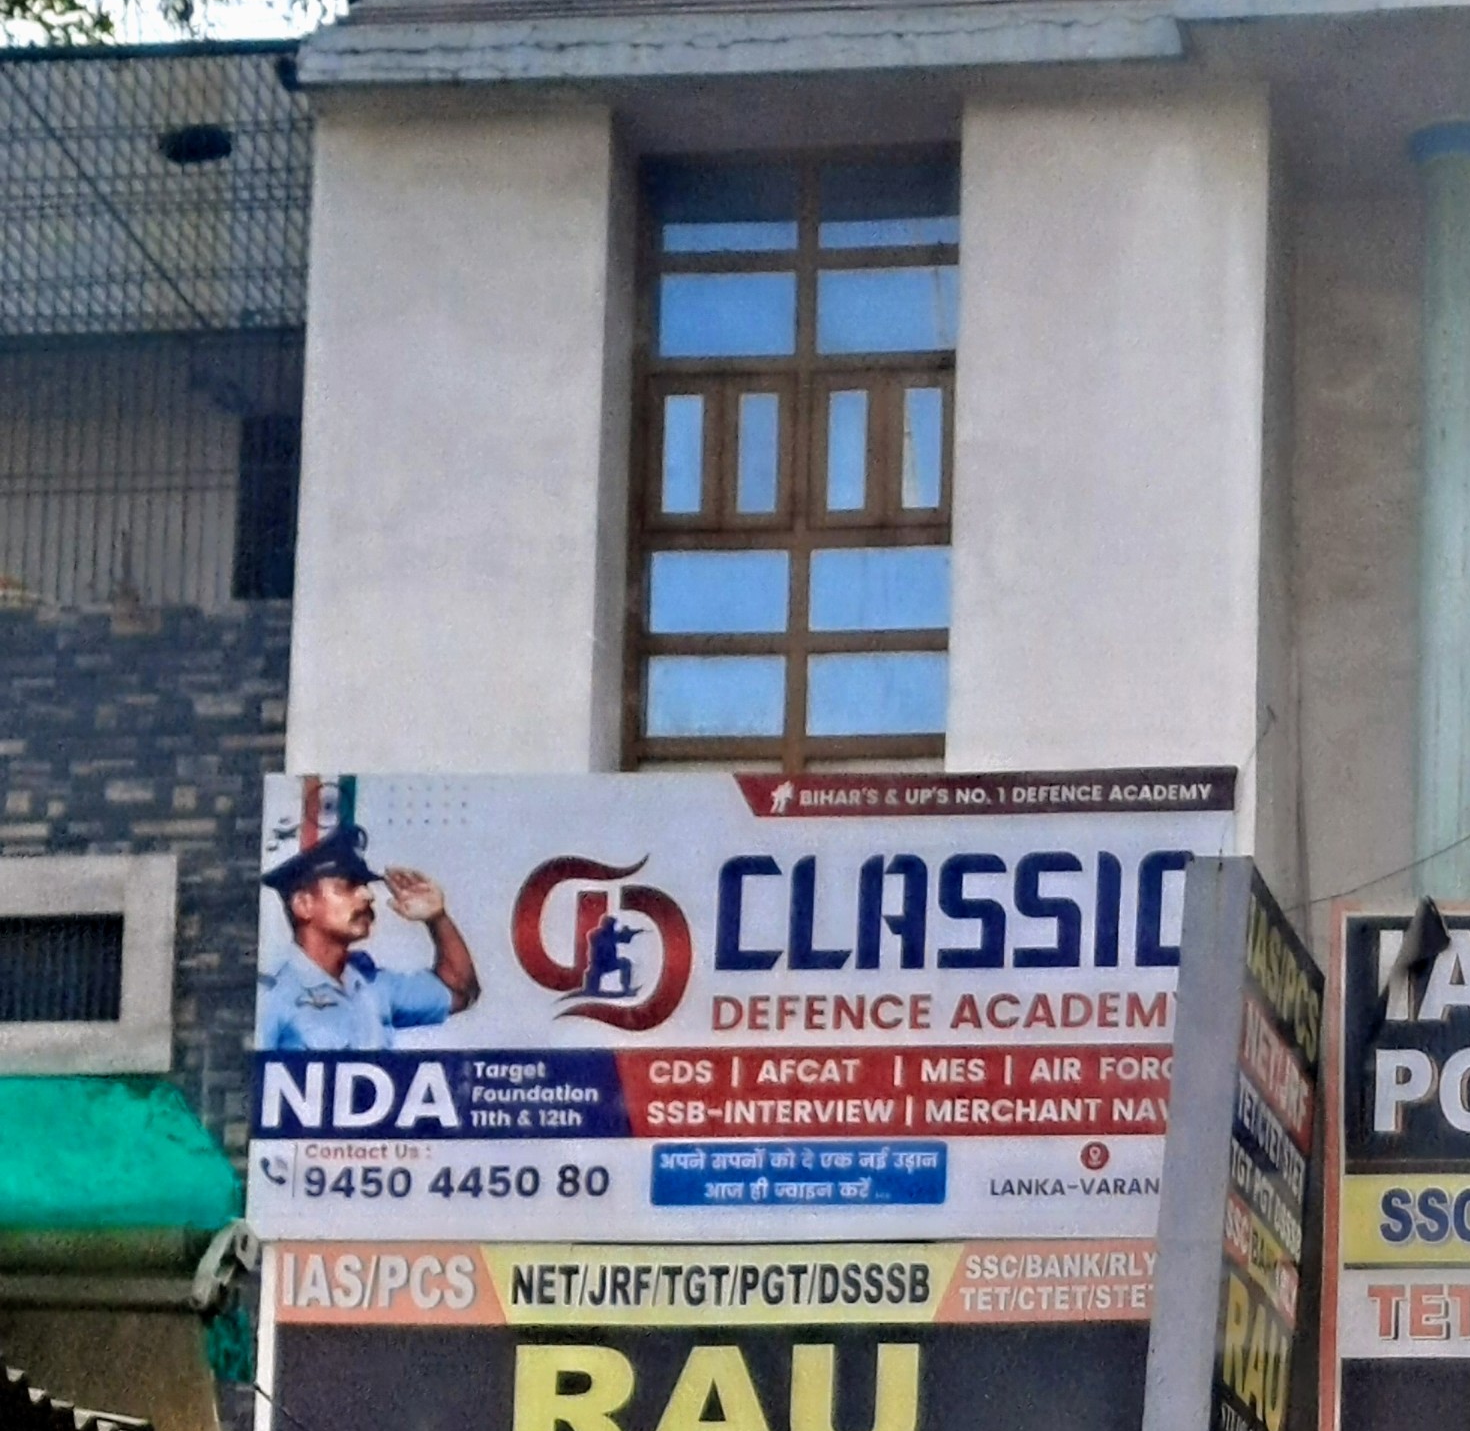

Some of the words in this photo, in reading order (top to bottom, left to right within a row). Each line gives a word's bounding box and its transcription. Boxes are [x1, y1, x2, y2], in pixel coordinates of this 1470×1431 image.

[800, 788, 877, 806] BIHAR'S
[905, 787, 948, 805] UP'S
[956, 787, 991, 805] NO.
[1012, 785, 1102, 804] DEFENCE
[1108, 783, 1212, 802] ACADEMY
[715, 850, 1191, 969] CLASSIC
[712, 994, 932, 1030] DEFENCE
[950, 992, 1178, 1029] ACADEM
[474, 1060, 546, 1083] Target
[649, 1059, 713, 1083] CDS
[757, 1058, 860, 1082] AFCAT
[921, 1058, 985, 1082] MES
[1030, 1057, 1081, 1081] AIR
[260, 1062, 458, 1128] NDA
[472, 1085, 599, 1103] Foundation
[470, 1109, 512, 1127] 11th
[516, 1110, 533, 1127] &
[539, 1109, 581, 1127] 12th
[647, 1099, 894, 1125] SSB-INTERVIEW
[925, 1098, 1102, 1123] MERCHANT
[305, 1144, 388, 1161] Contact
[394, 1144, 420, 1161] Us
[660, 1148, 706, 1169] अपने
[769, 1148, 797, 1169] को
[820, 1151, 853, 1169] एक
[858, 1146, 890, 1170] नई
[305, 1167, 411, 1198] 9450
[429, 1167, 541, 1198] 4450
[557, 1165, 610, 1197] 80
[704, 1181, 744, 1199] आज
[750, 1177, 770, 1202] ही
[281, 1253, 477, 1310] IAS/PCS
[511, 1262, 930, 1306] NET/JRF/TGT/PGT/DSSSB
[960, 1284, 1154, 1312] TET/CTET/STE
